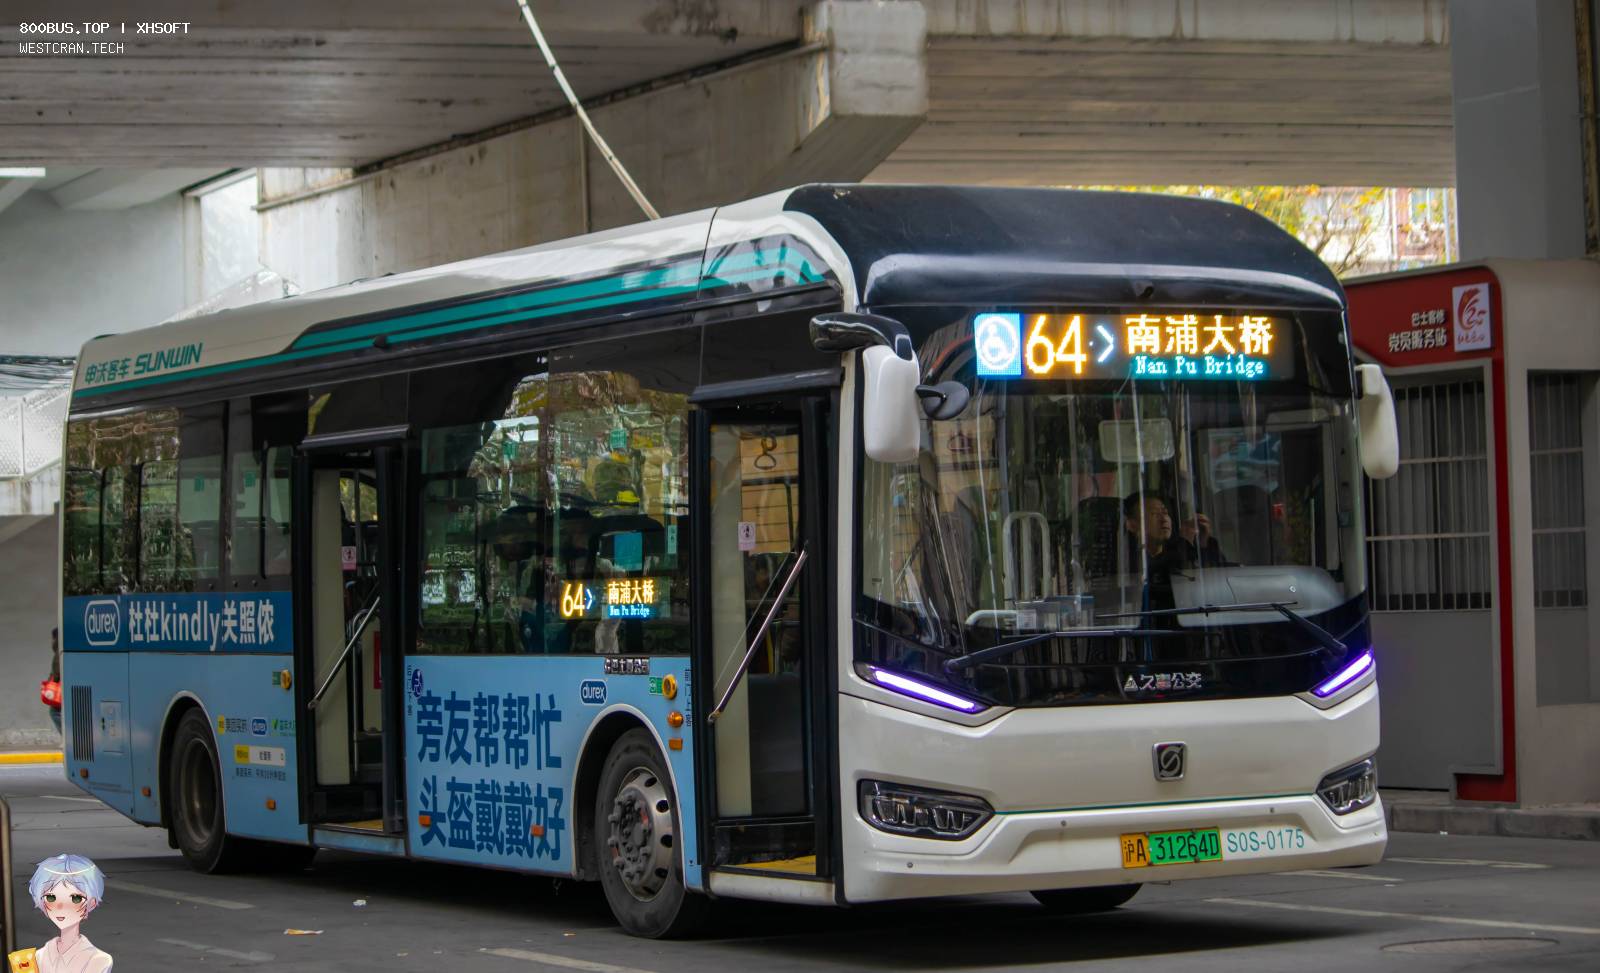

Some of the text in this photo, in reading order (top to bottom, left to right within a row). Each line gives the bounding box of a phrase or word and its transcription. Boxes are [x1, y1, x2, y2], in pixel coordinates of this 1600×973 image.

[85, 342, 204, 385] 申沃客车 SUNWIN
[1025, 313, 1274, 375] 64 南浦大桥
[1135, 354, 1265, 378] Nan Pu Bridge
[562, 579, 655, 617] 64 南浦大桥
[88, 607, 118, 635] durex
[582, 681, 606, 700] durex
[416, 689, 563, 771] 旁友帮帮忙
[418, 775, 566, 861] 头盔戴戴好
